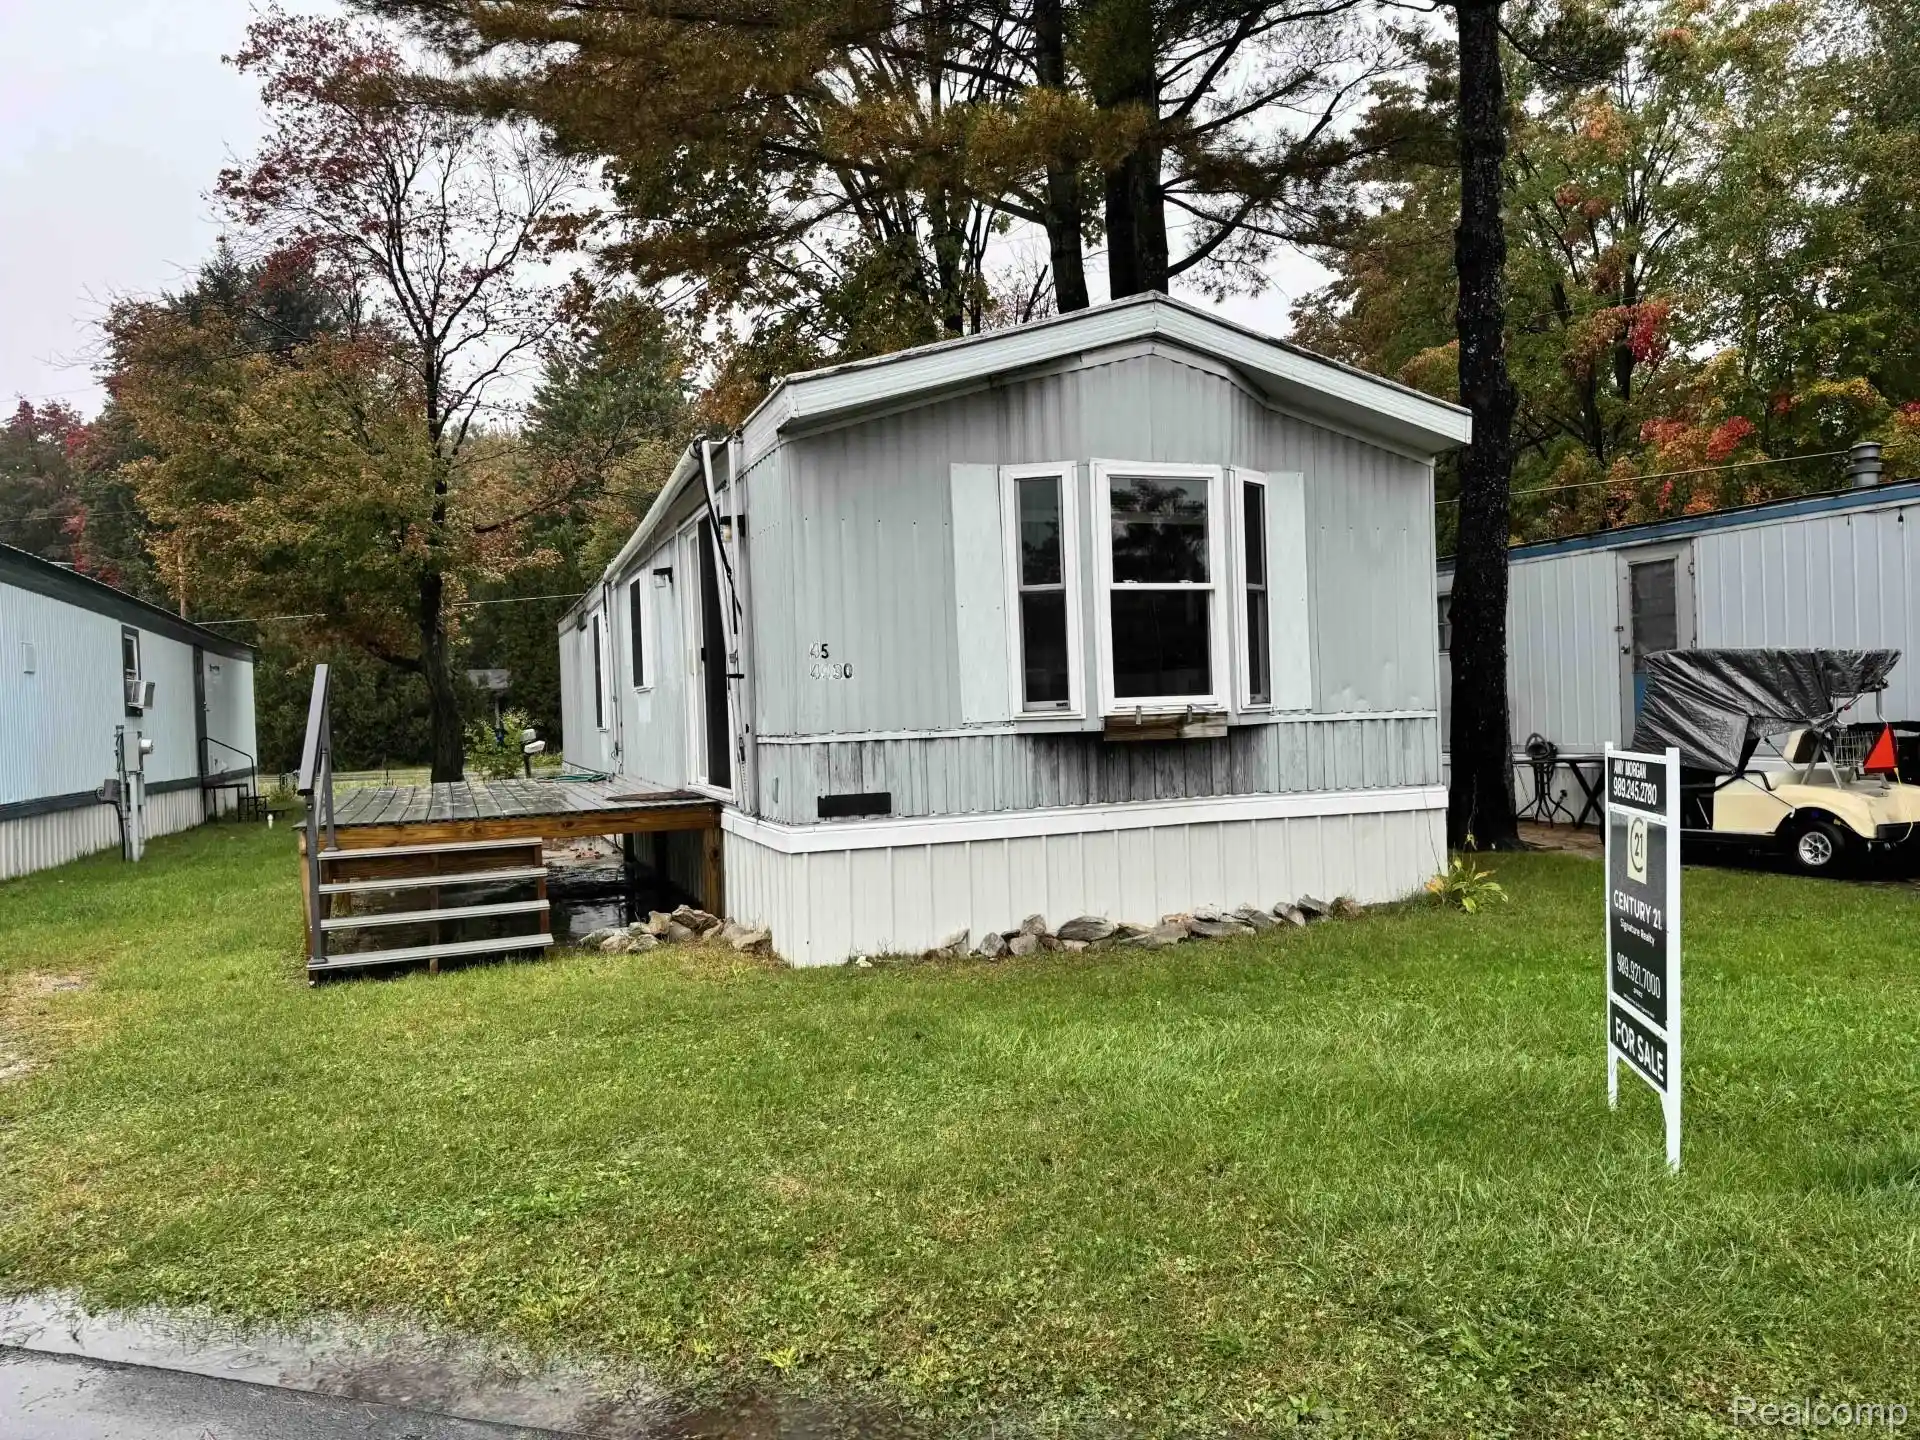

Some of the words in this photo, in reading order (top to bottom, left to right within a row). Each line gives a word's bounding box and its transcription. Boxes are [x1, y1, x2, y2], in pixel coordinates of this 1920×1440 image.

[1625, 761, 1647, 779] MORGAN
[1613, 776, 1657, 806] 989.245.2780
[1613, 889, 1652, 924] CENTURY
[1652, 907, 1663, 931] 21
[1615, 1016, 1636, 1057] FOR
[1637, 1034, 1665, 1083] SALE
